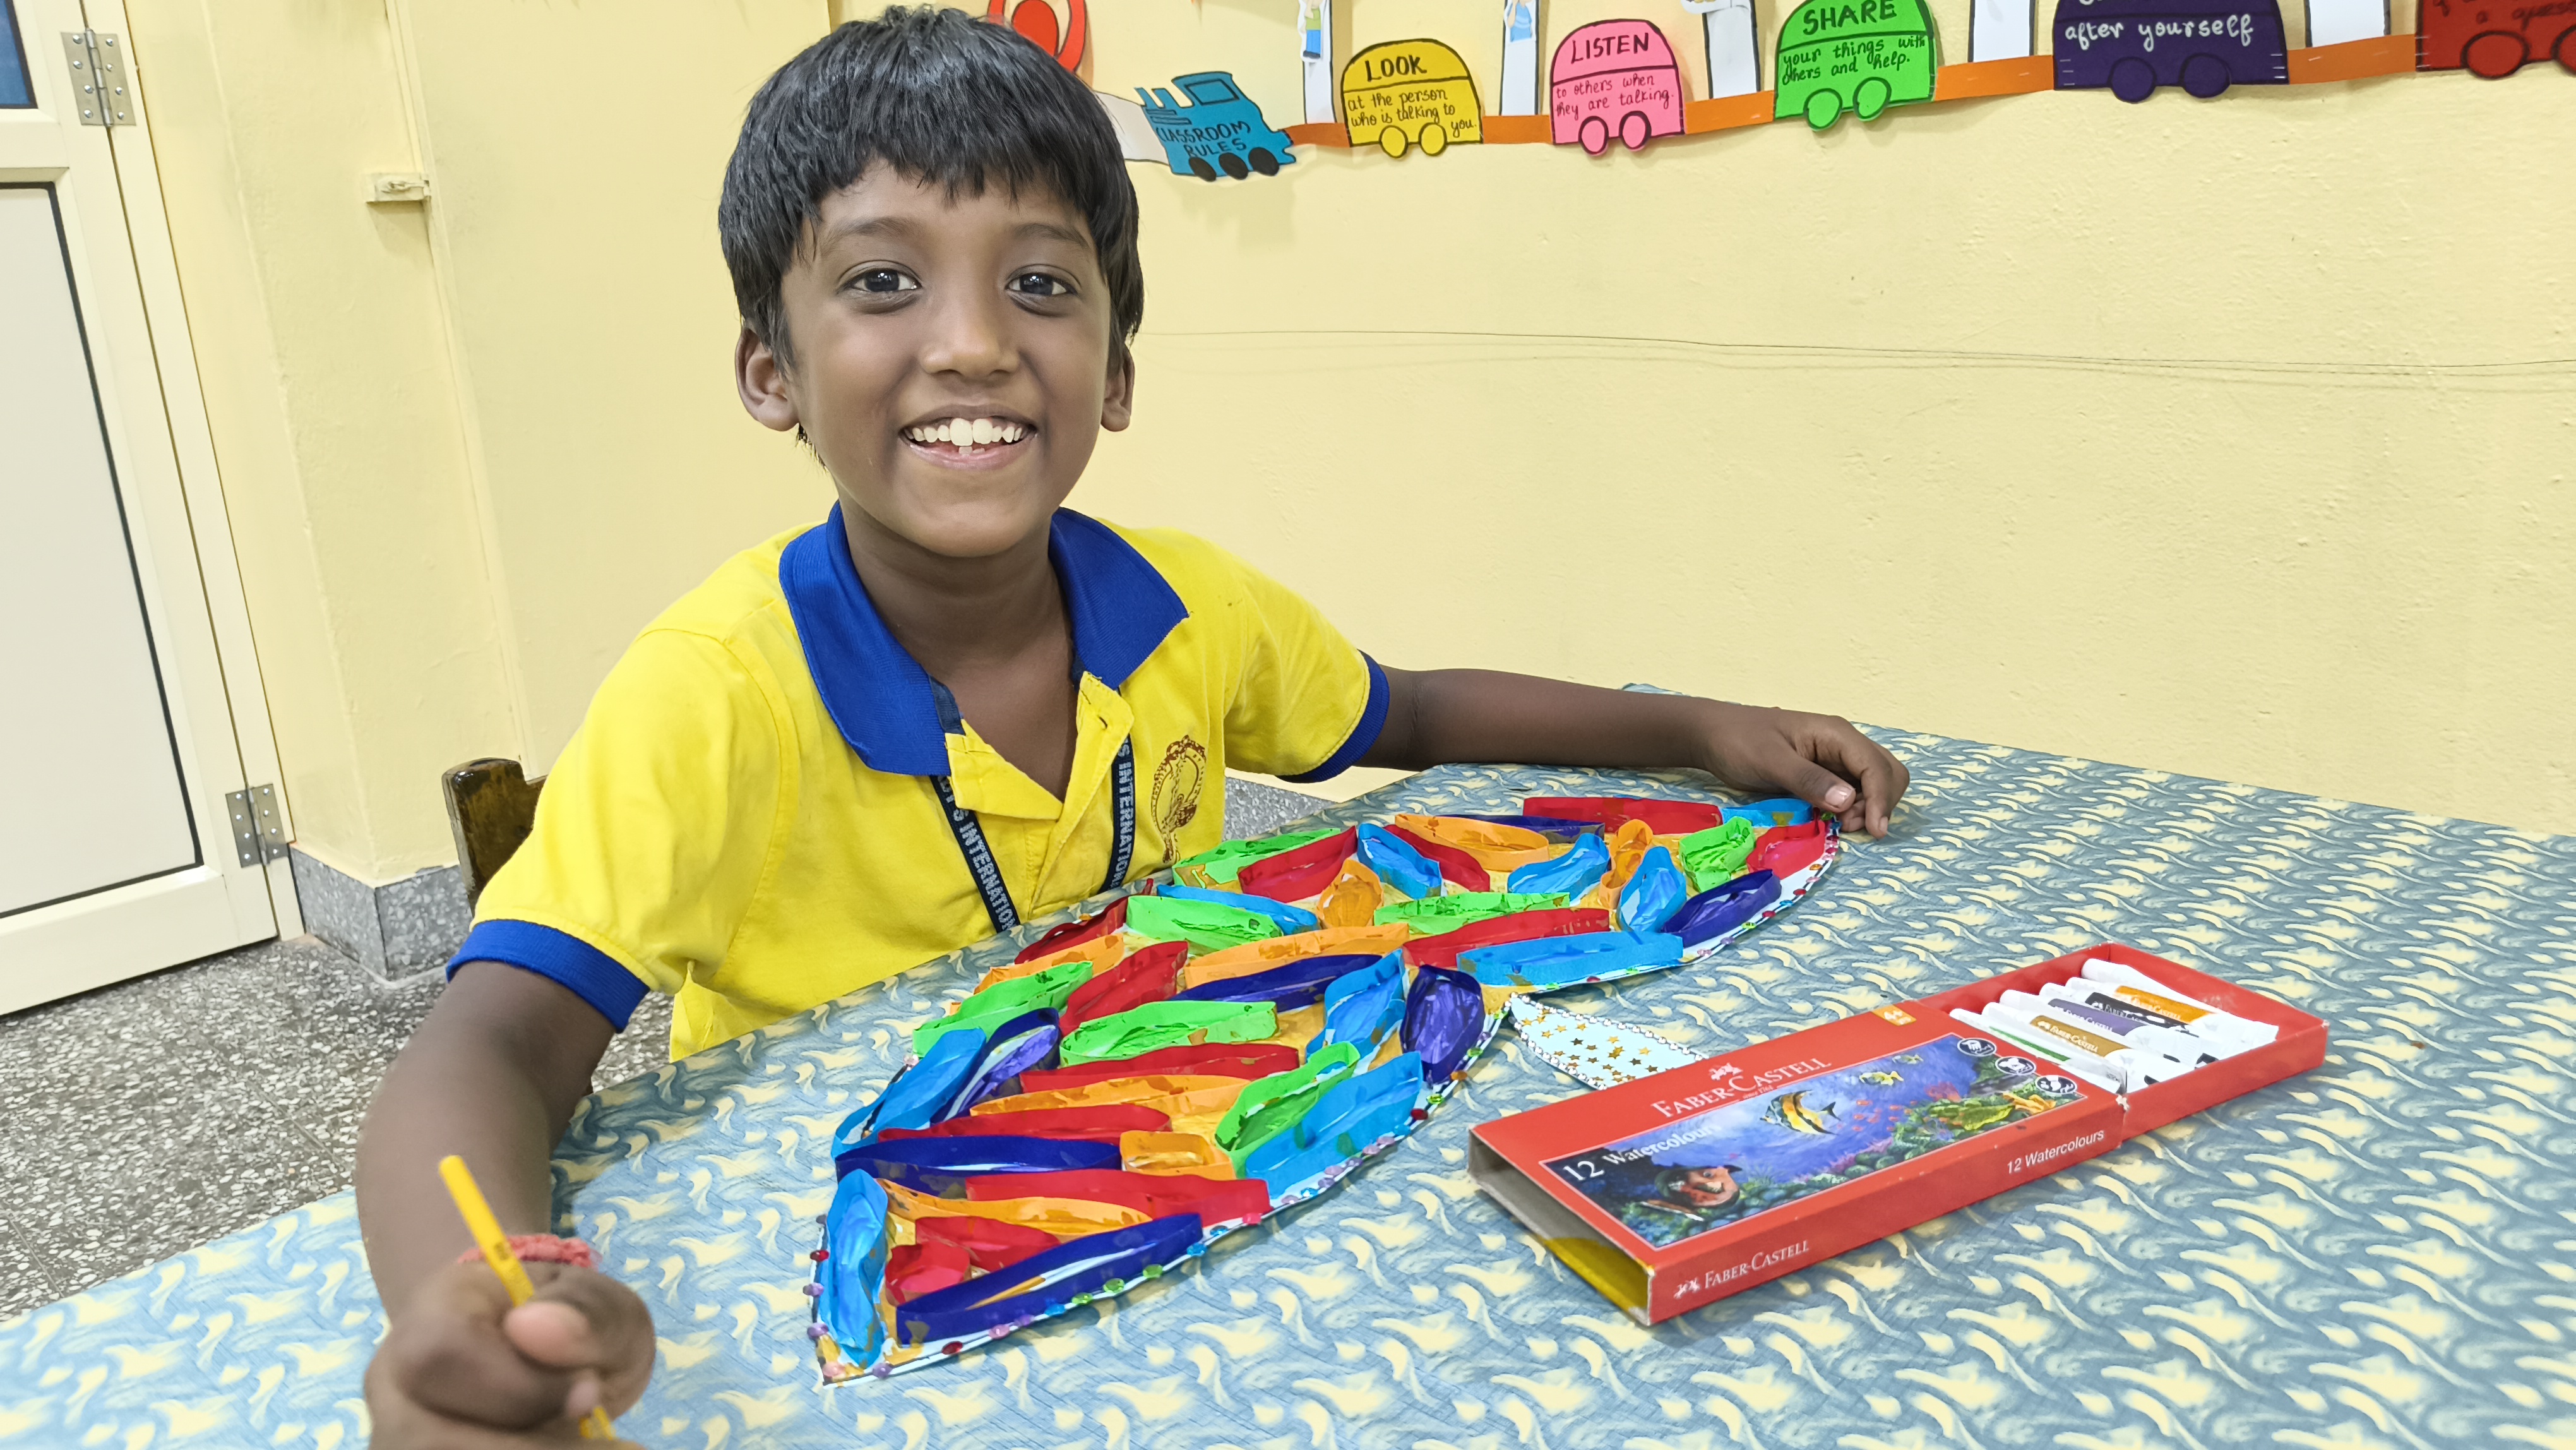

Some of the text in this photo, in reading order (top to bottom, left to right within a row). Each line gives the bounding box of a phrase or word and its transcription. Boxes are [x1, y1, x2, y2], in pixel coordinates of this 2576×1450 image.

[1803, 0, 1897, 35] SHARE
[2065, 13, 2254, 52] after yourself
[1570, 32, 1649, 64] LISTEN
[1783, 35, 1925, 66] your things with
[1364, 54, 1428, 82] LOOK
[1782, 51, 1911, 86] others and help.
[1347, 88, 1448, 112] at the person
[1556, 73, 1655, 99] to others when
[1351, 103, 1456, 127] who is talking to
[1555, 87, 1674, 121] they are talking.
[1155, 120, 1251, 144] CLASSROOM
[1450, 119, 1477, 138] you.
[1183, 137, 1247, 158] RULES
[1650, 1058, 1832, 1118] FABER-CASTELL
[1563, 1124, 1722, 1181] 12 Watercolours
[2007, 1129, 2105, 1175] 12 Watercolours
[1705, 1240, 1810, 1290] FABER-CASTELL
